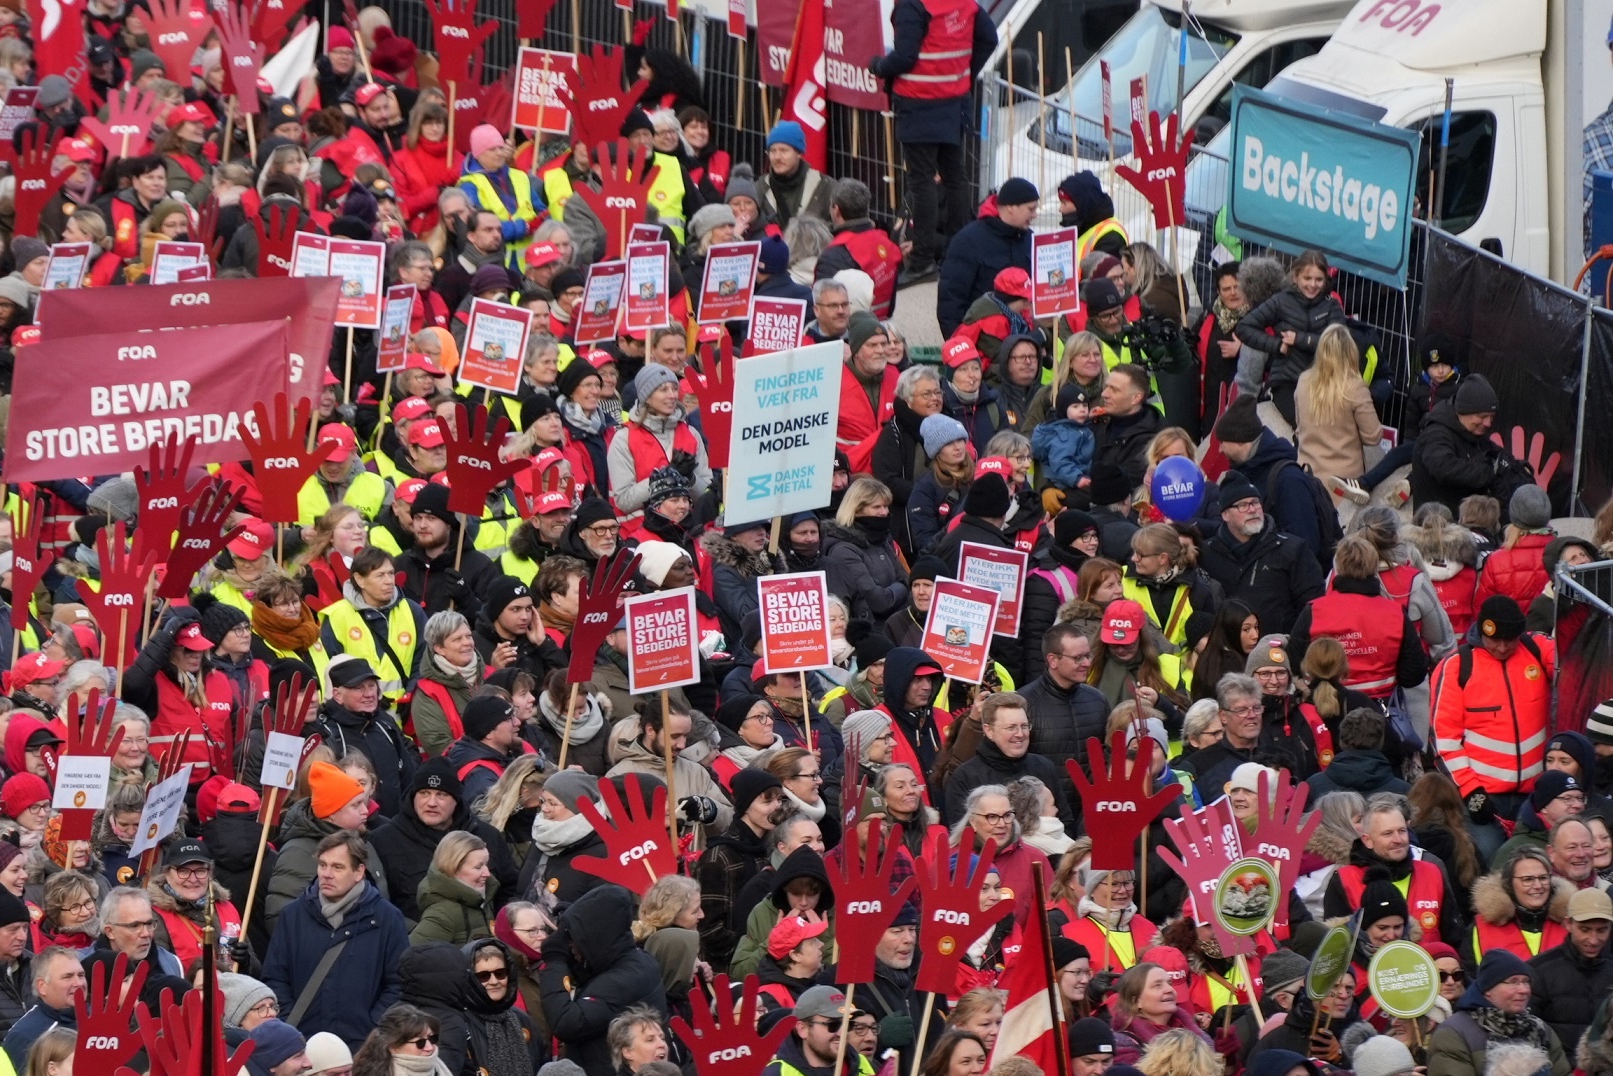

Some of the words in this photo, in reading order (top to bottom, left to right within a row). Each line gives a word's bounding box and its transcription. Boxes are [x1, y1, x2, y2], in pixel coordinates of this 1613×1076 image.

[1360, 0, 1437, 38] FOA
[159, 31, 189, 45] FOA
[442, 26, 469, 38] FOA
[826, 58, 878, 91] EDEDAG
[589, 98, 618, 111] FOA
[1148, 166, 1176, 181] FOA
[1243, 136, 1398, 239] Backstage
[607, 197, 636, 208] FOA
[171, 292, 210, 306] FOA
[756, 313, 798, 330] BEVAR
[753, 326, 797, 344] STORE
[118, 346, 156, 360] FOA
[755, 368, 824, 393] FINGRENE
[92, 381, 190, 416] BEVAR
[408, 398, 427, 409] FOA
[758, 388, 792, 409] VÆK
[793, 385, 819, 403] FRA
[711, 402, 732, 412] FO
[741, 423, 771, 440] DEN
[774, 413, 829, 435] DANSKE
[26, 426, 119, 460] STORE
[125, 409, 261, 452] BEDEDAG
[759, 435, 809, 454] MODEL
[265, 457, 298, 468] FOA
[458, 456, 491, 469] FOA
[774, 466, 815, 484] DANSK
[774, 477, 813, 495] METAL
[1161, 482, 1193, 495] BEVAR
[149, 497, 177, 509] FOA
[184, 538, 210, 549] FOA
[105, 594, 133, 605] FOA
[767, 588, 819, 608] BEVAR
[584, 612, 607, 623] FOA
[634, 610, 685, 629] BEVAR
[768, 605, 821, 622] STORE
[769, 619, 821, 633] BEDEDAG
[1110, 619, 1132, 628] FOA
[635, 624, 686, 641] STORE
[636, 639, 687, 654] BEDEDAG
[1096, 801, 1136, 812] FOA
[621, 840, 657, 866] FOA
[847, 901, 882, 914] FOA
[933, 909, 970, 925] FOA
[86, 1036, 118, 1049] FOA
[709, 1045, 751, 1064] FOA
